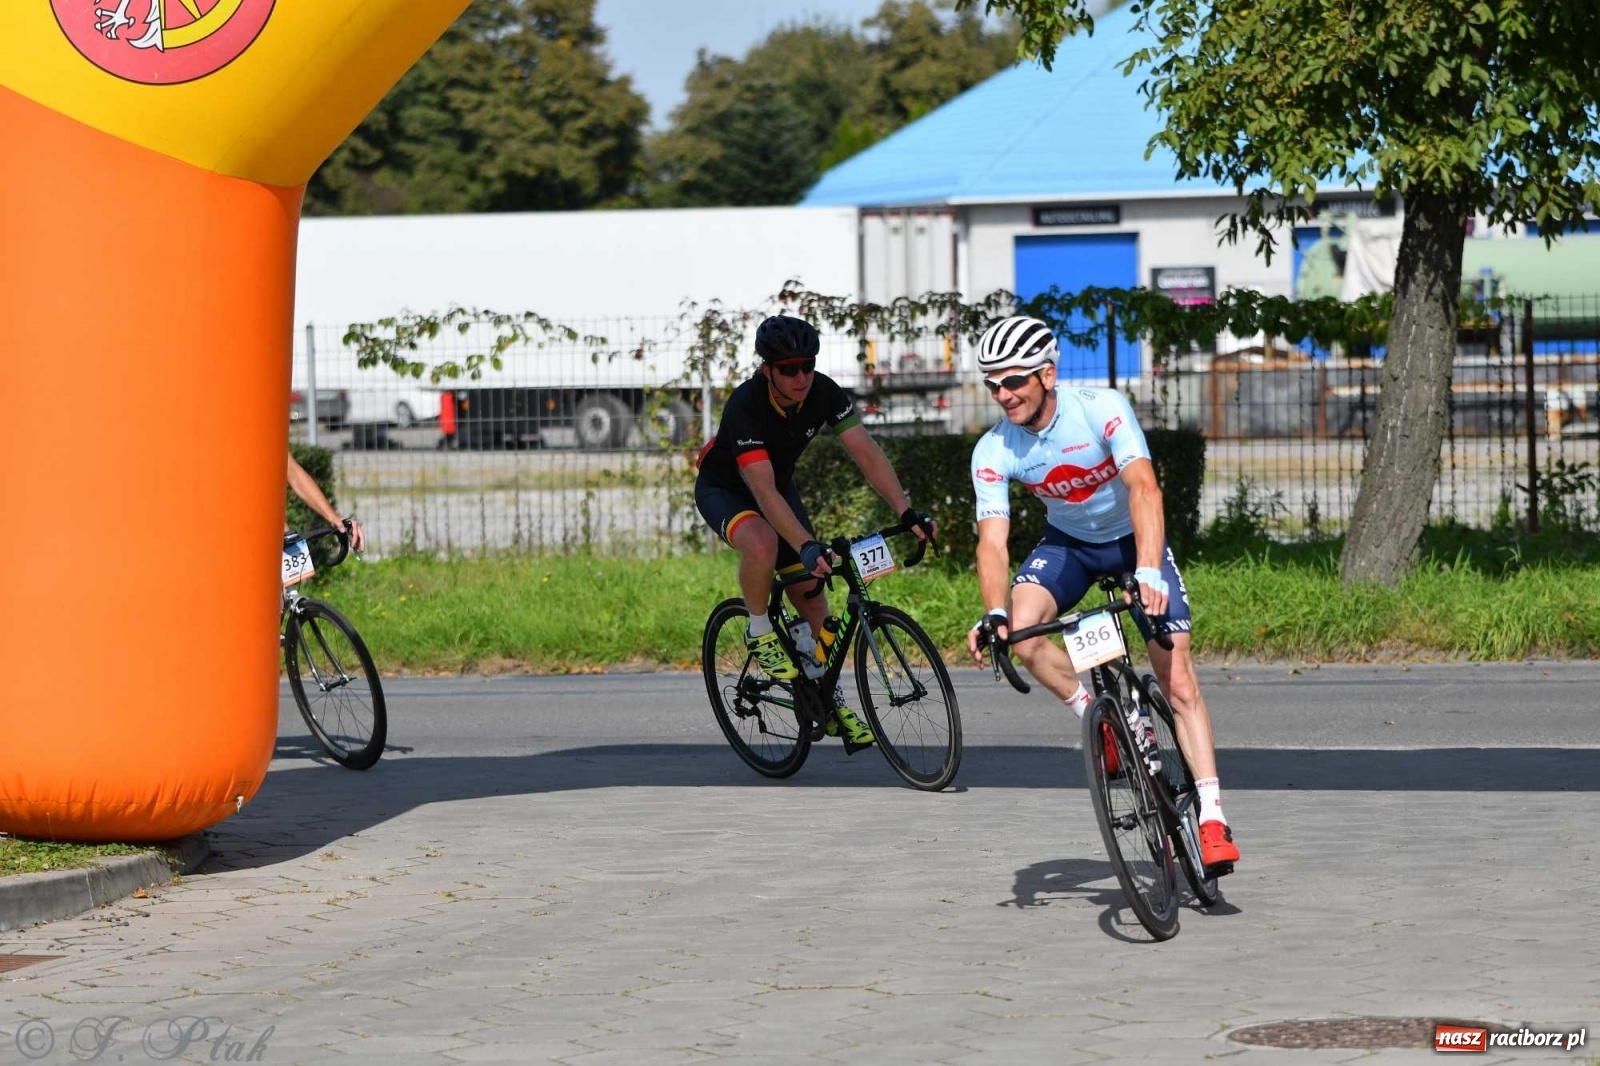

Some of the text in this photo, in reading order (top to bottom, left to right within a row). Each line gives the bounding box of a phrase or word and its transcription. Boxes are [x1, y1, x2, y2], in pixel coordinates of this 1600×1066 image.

[1036, 464, 1115, 497] Alpecin
[283, 552, 307, 572] 383
[859, 545, 884, 566] 377
[1073, 625, 1111, 652] 386
